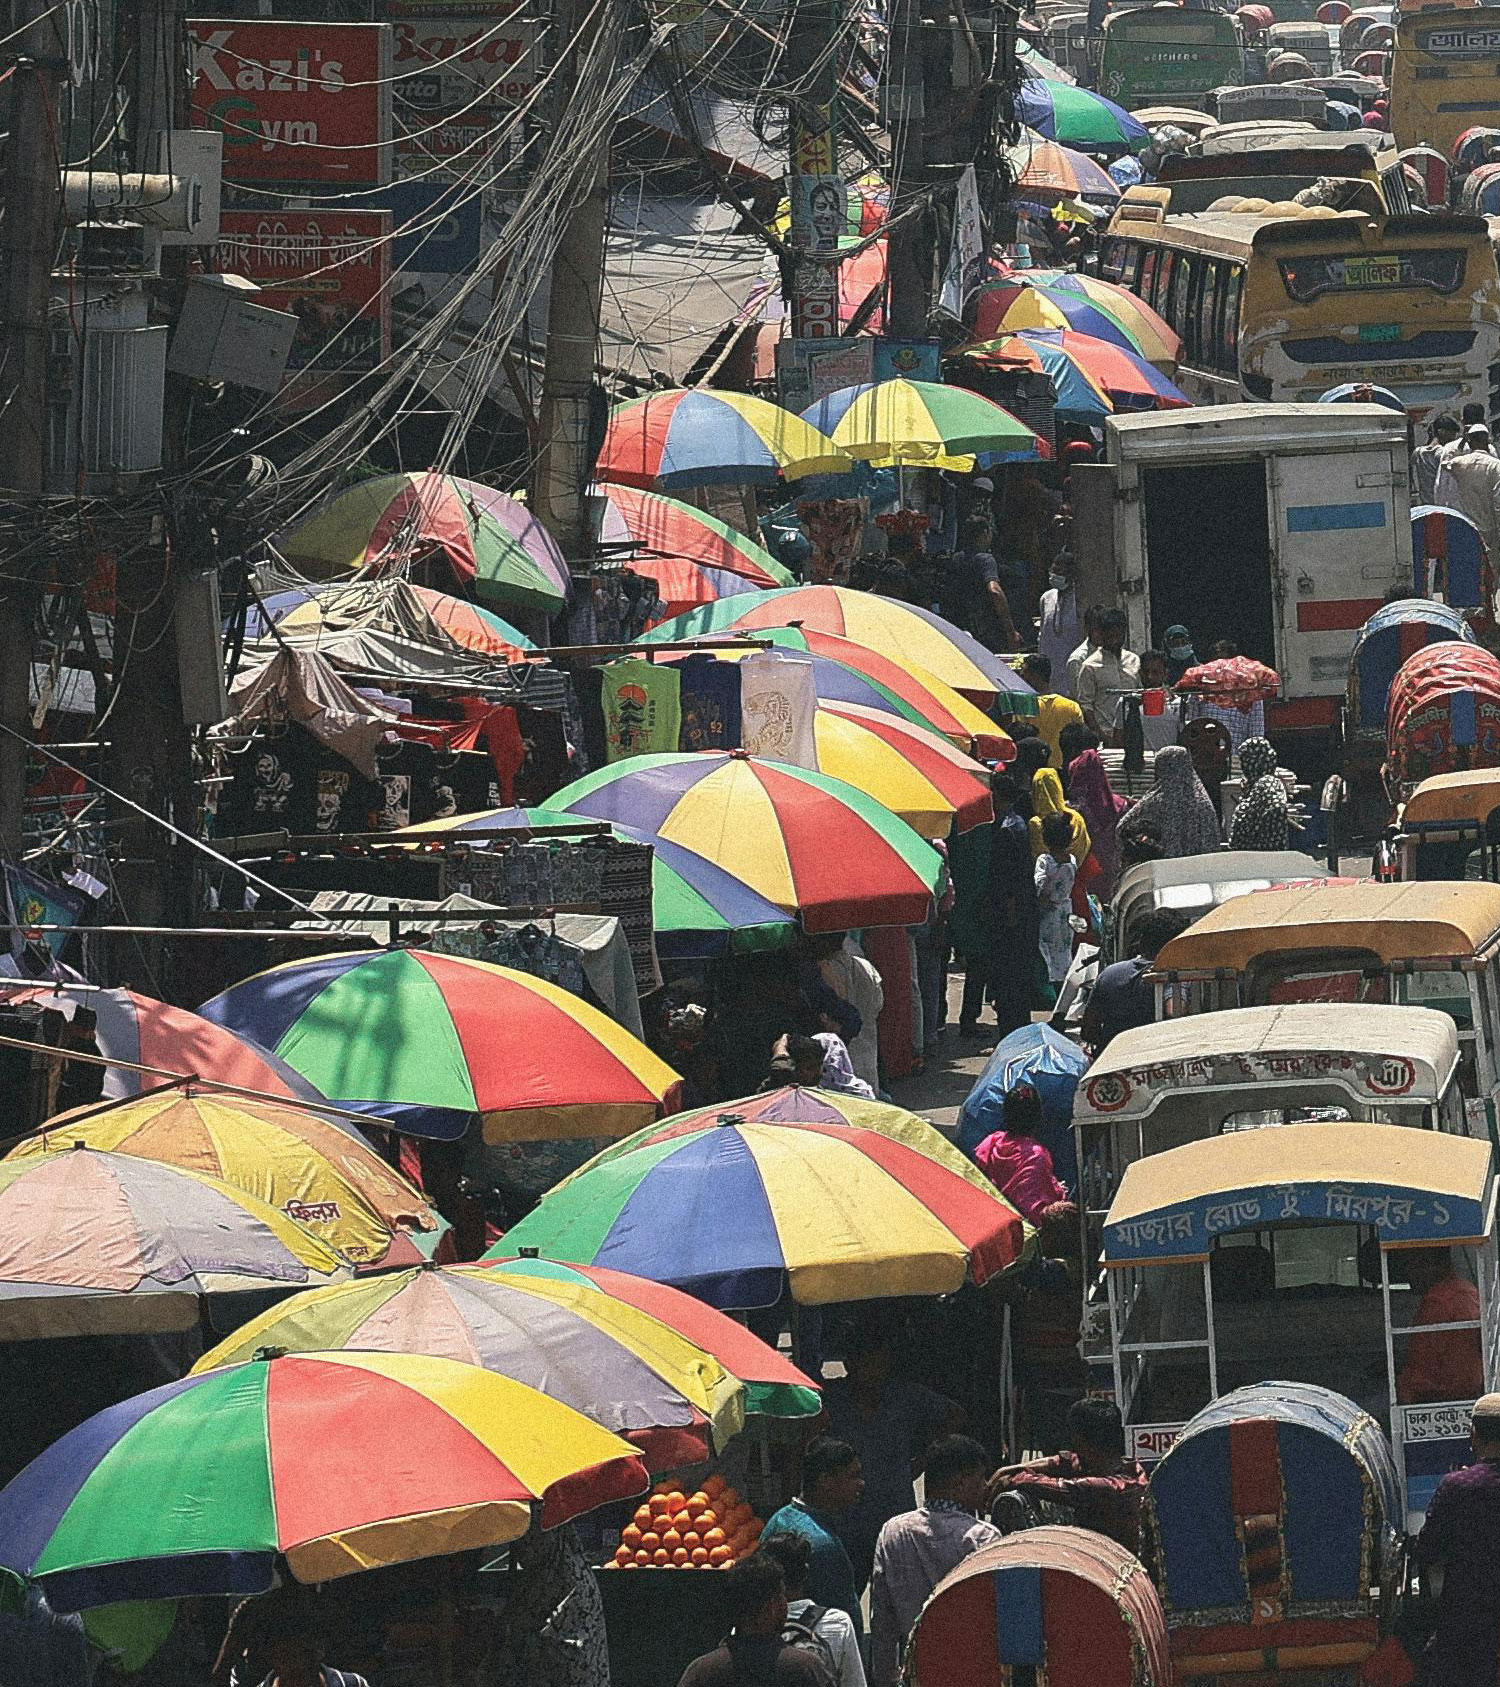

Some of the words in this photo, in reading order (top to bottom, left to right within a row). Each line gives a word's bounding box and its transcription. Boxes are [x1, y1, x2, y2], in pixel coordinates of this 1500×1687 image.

[190, 31, 345, 94] Kazi's
[210, 99, 318, 151] Gym
[1116, 1212, 1194, 1248] মাজার
[1204, 1198, 1261, 1232] রোড
[1409, 1412, 1432, 1424] ঢাকা
